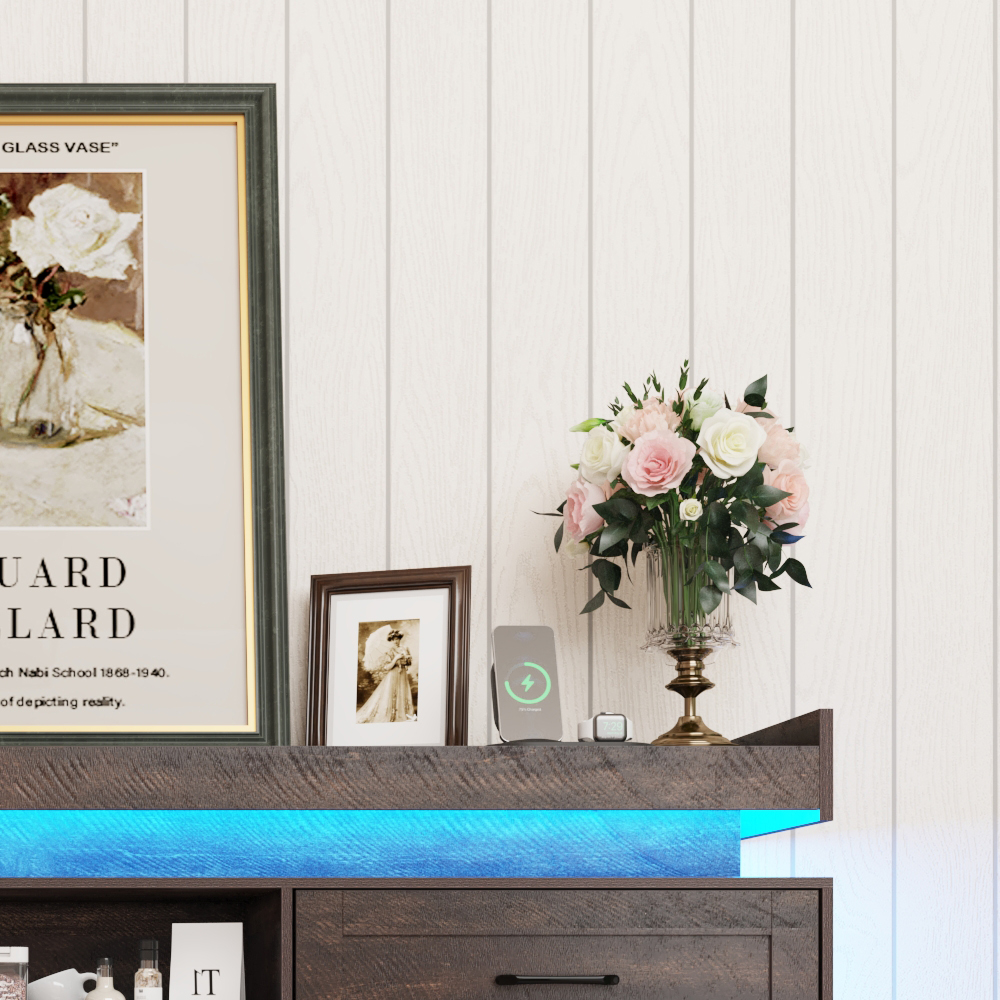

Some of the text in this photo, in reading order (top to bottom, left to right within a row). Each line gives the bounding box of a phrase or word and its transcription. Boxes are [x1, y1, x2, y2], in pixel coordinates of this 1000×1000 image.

[2, 141, 60, 154] GLASS
[64, 141, 119, 154] VASE”
[18, 667, 48, 678] Nabi
[52, 667, 97, 678] School
[0, 696, 13, 708] of
[16, 696, 78, 710] depicting
[82, 697, 126, 710] reality.
[603, 721, 623, 731] 7:29
